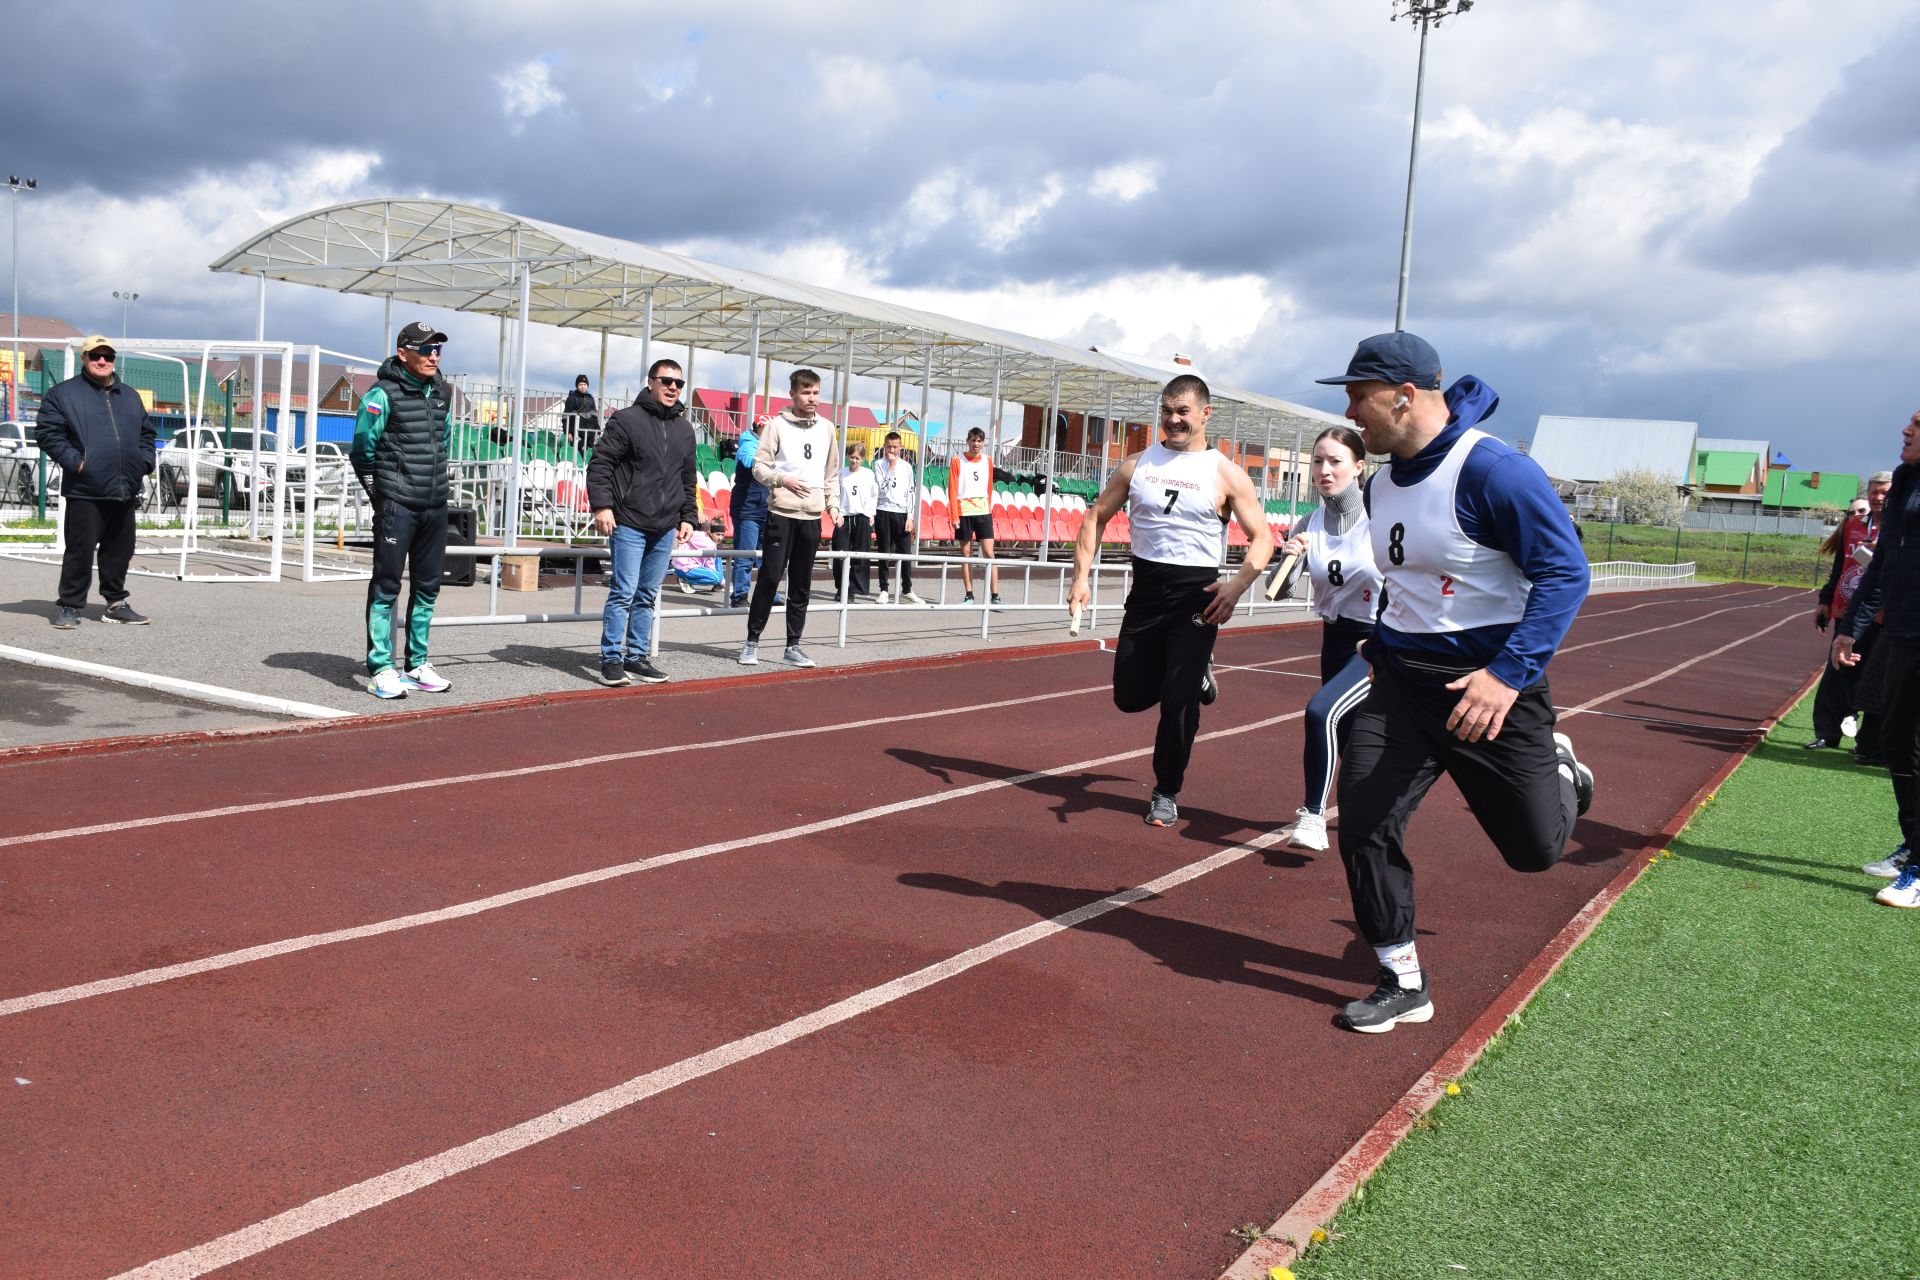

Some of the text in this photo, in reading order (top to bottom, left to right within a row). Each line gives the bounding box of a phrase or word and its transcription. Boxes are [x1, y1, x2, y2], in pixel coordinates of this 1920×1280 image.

[804, 444, 812, 460] 8
[973, 471, 979, 482] 5
[852, 485, 858, 496] 5
[1163, 489, 1179, 515] 7
[1389, 523, 1404, 566] 8
[1328, 560, 1344, 586] 8
[1440, 575, 1454, 596] 2
[1363, 590, 1372, 602] 3
